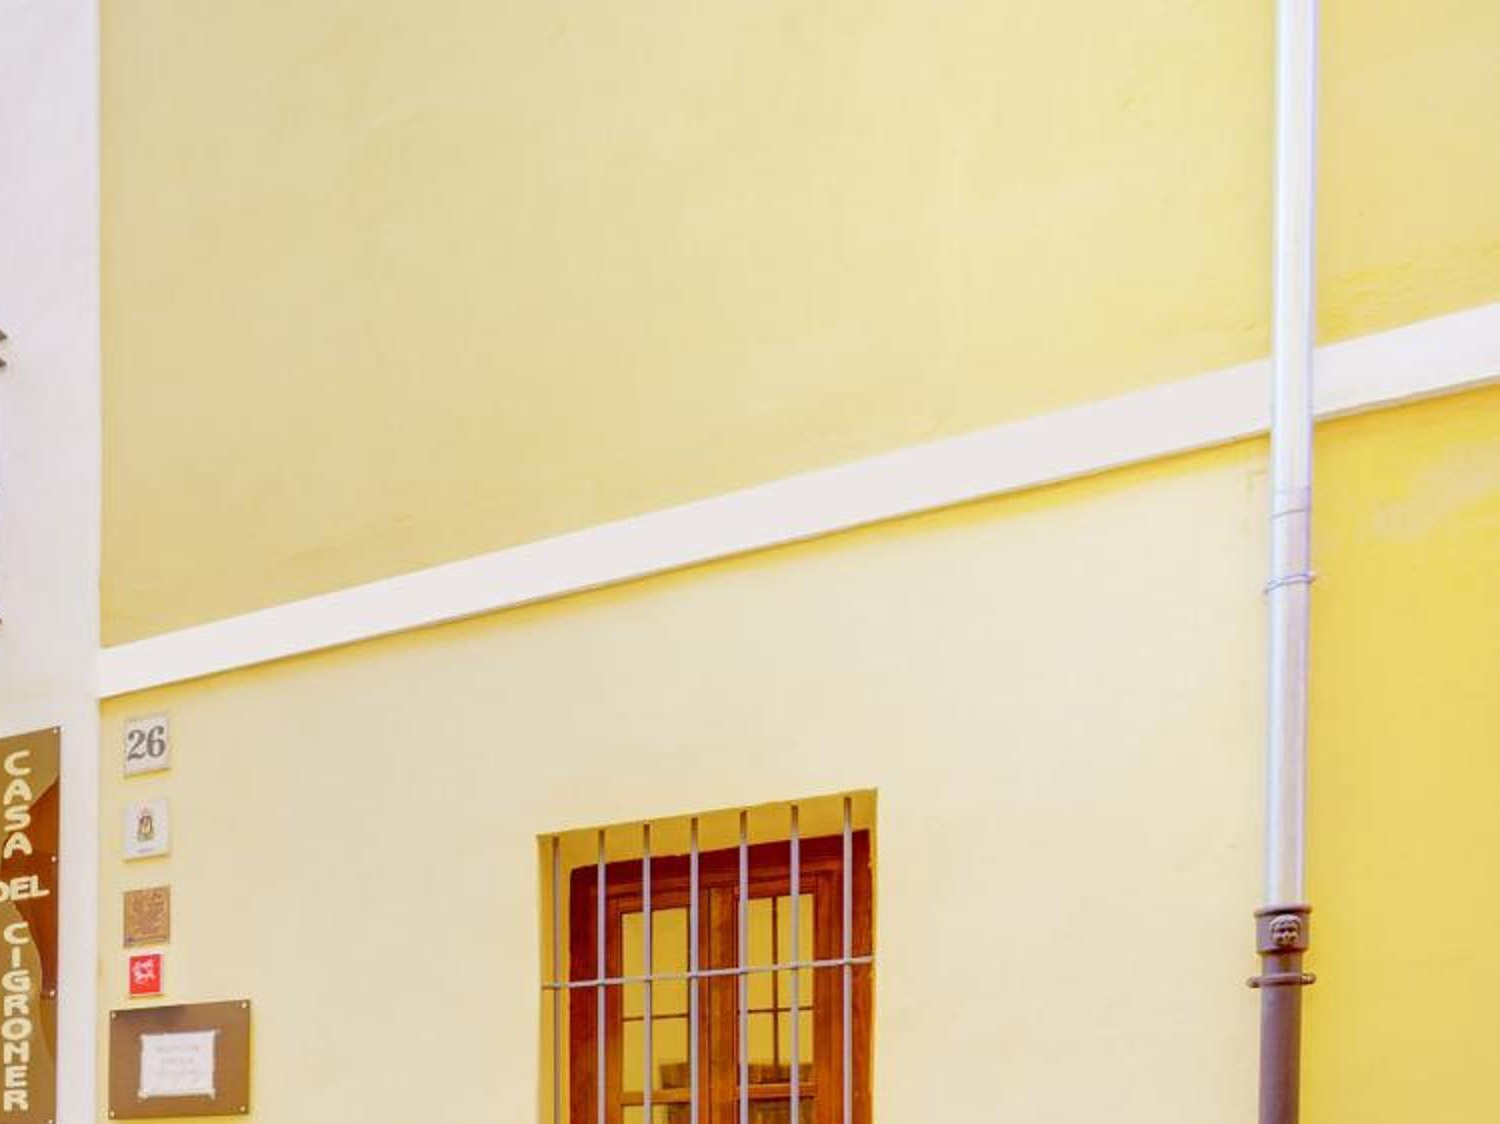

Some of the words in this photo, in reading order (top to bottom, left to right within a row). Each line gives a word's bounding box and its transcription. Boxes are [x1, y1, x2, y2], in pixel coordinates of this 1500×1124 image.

[127, 725, 166, 761] 26
[3, 750, 33, 860] CASA
[1, 921, 32, 1113] CIGRONER
